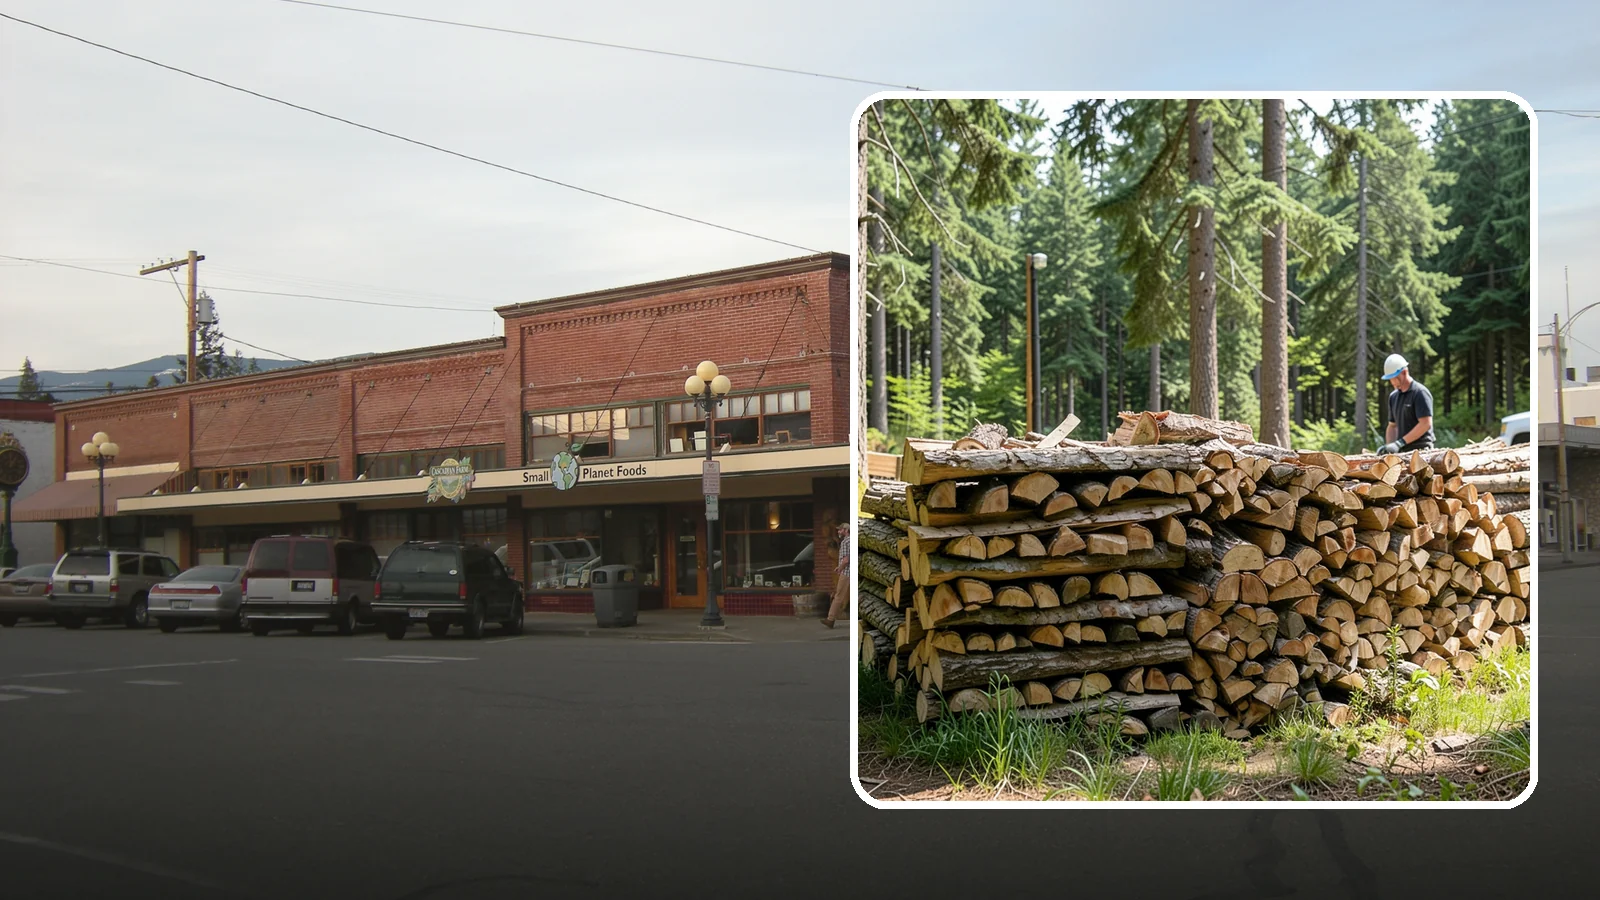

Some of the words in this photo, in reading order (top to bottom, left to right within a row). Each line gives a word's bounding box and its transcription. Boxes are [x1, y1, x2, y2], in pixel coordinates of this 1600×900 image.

[523, 471, 549, 483] Small
[583, 467, 614, 479] Planet
[617, 464, 647, 477] Foods
